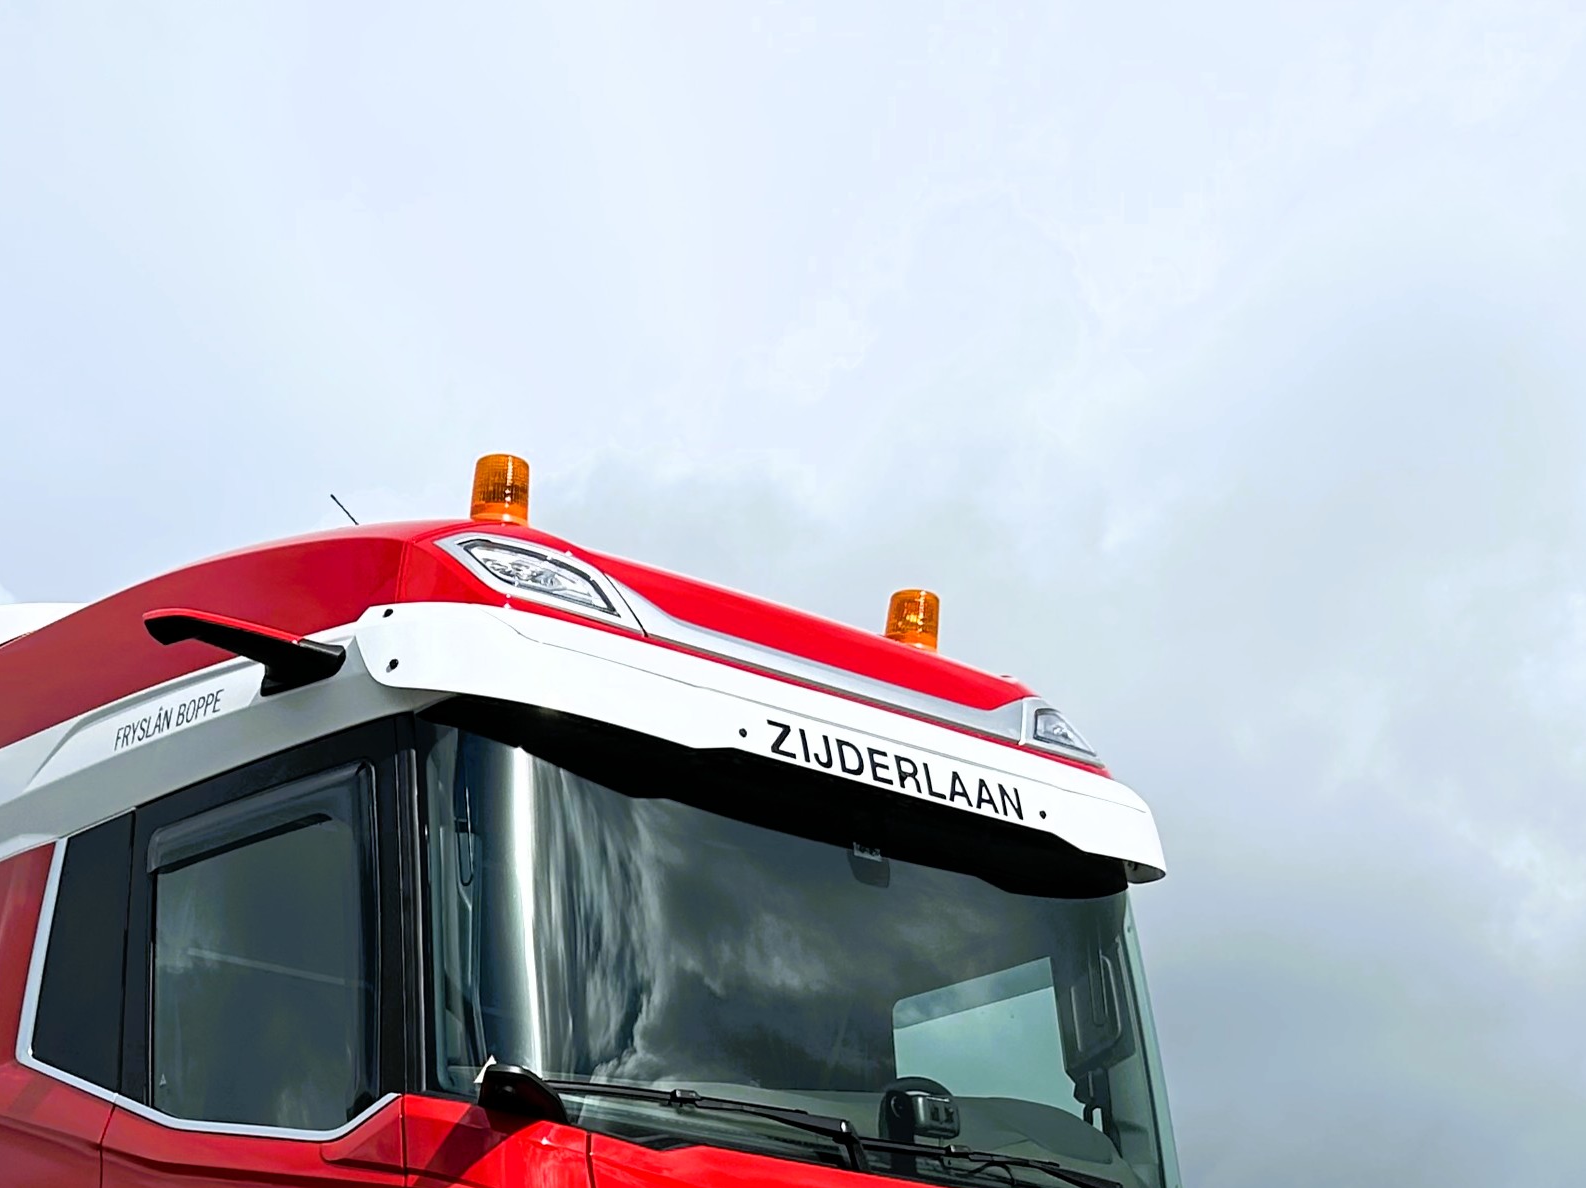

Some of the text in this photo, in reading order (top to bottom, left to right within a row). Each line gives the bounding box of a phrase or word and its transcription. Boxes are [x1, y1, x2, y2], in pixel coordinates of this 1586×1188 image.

[113, 688, 225, 752] FRYSLÂN BOPPE
[766, 719, 1024, 821] ZIJDERLAAN
